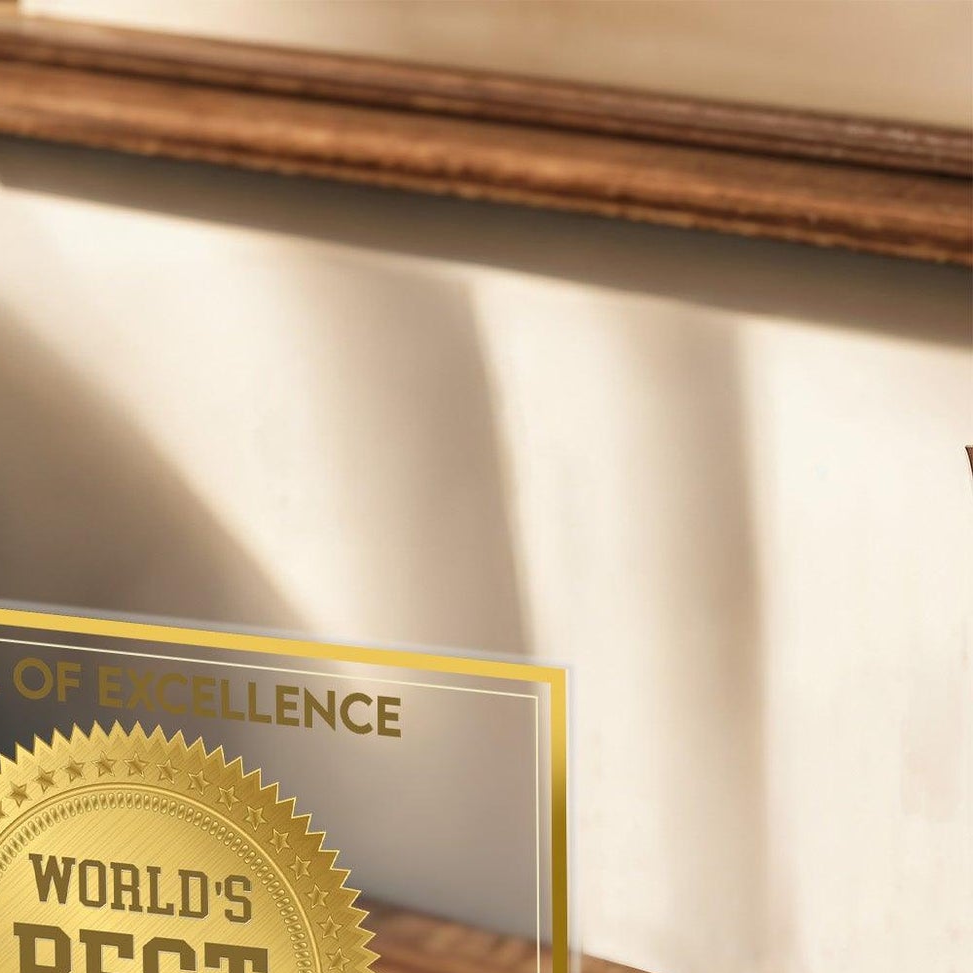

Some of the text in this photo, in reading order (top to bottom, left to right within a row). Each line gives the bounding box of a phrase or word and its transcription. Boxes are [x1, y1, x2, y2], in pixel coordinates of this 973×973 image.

[13, 657, 81, 701] OF
[98, 666, 402, 738] EXCELLENCE
[28, 853, 252, 924] WORLD'S
